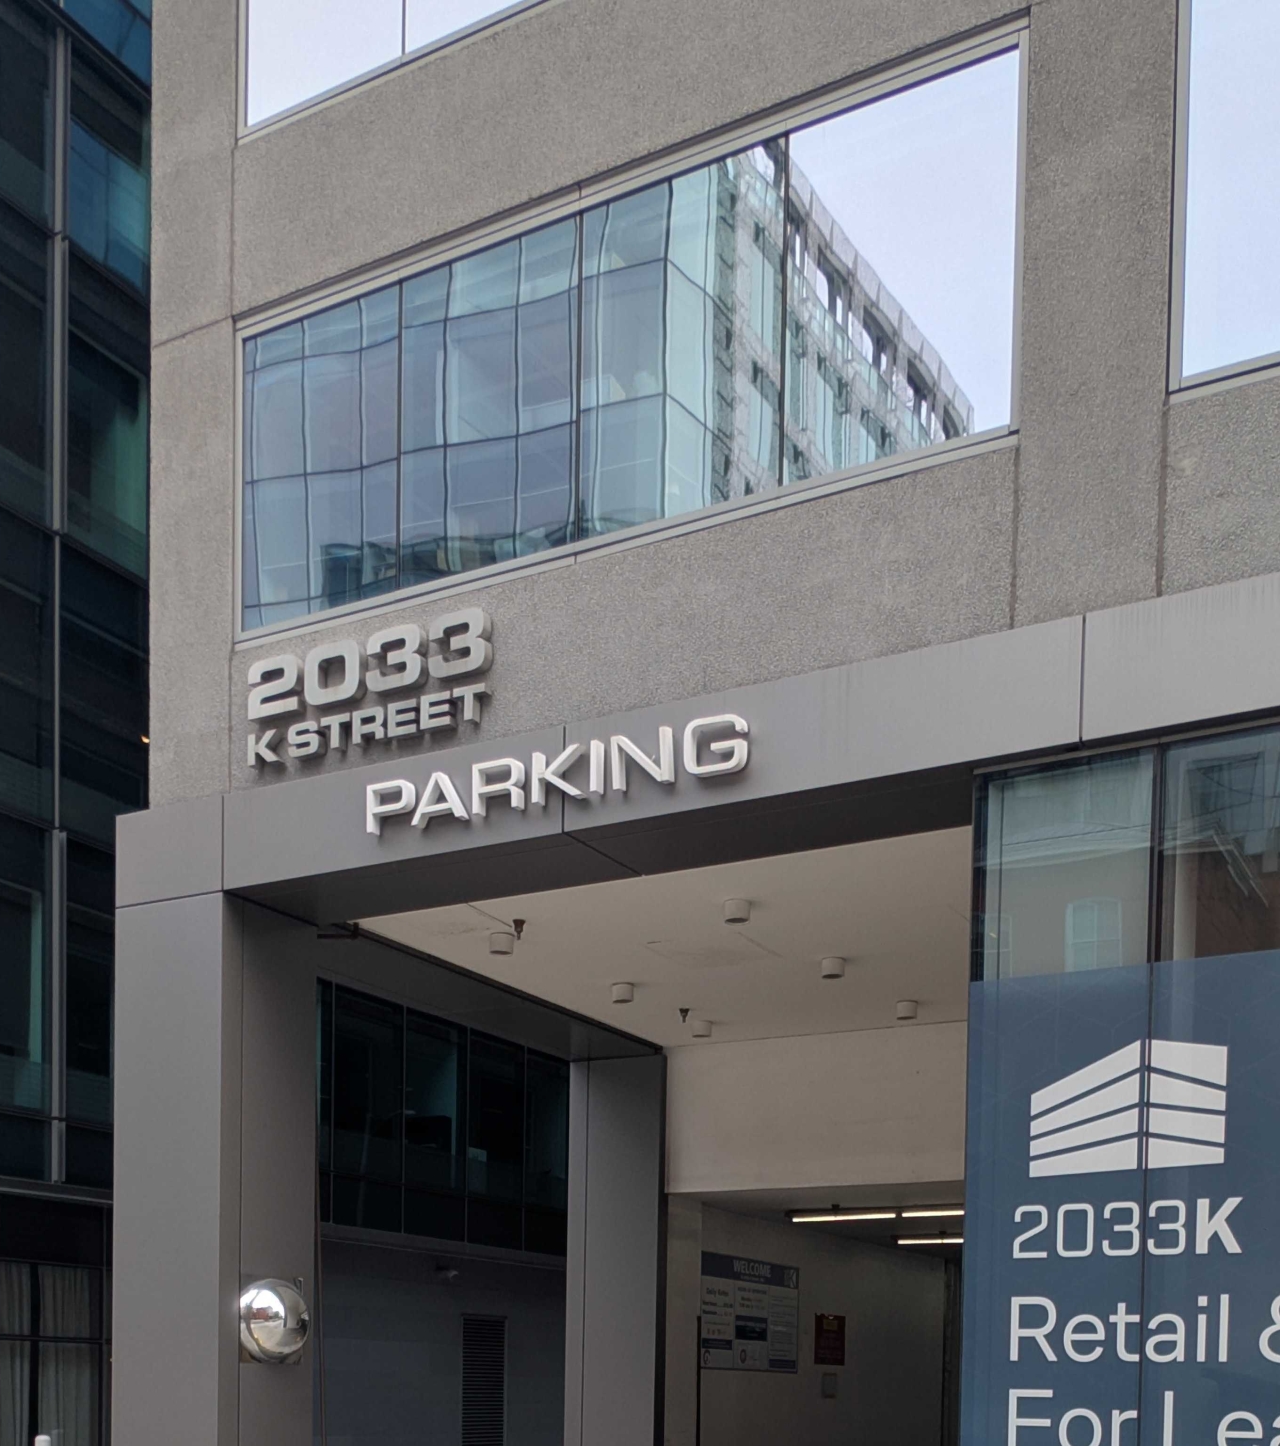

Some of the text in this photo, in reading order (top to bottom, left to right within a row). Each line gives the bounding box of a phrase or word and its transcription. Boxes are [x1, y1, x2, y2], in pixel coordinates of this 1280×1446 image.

[247, 607, 491, 721] 2033
[247, 683, 491, 766] K STREET
[365, 713, 749, 835] PARKING
[1012, 1197, 1243, 1259] 2033K
[732, 1258, 772, 1278] WELCOME
[1008, 1294, 1229, 1363] Retail
